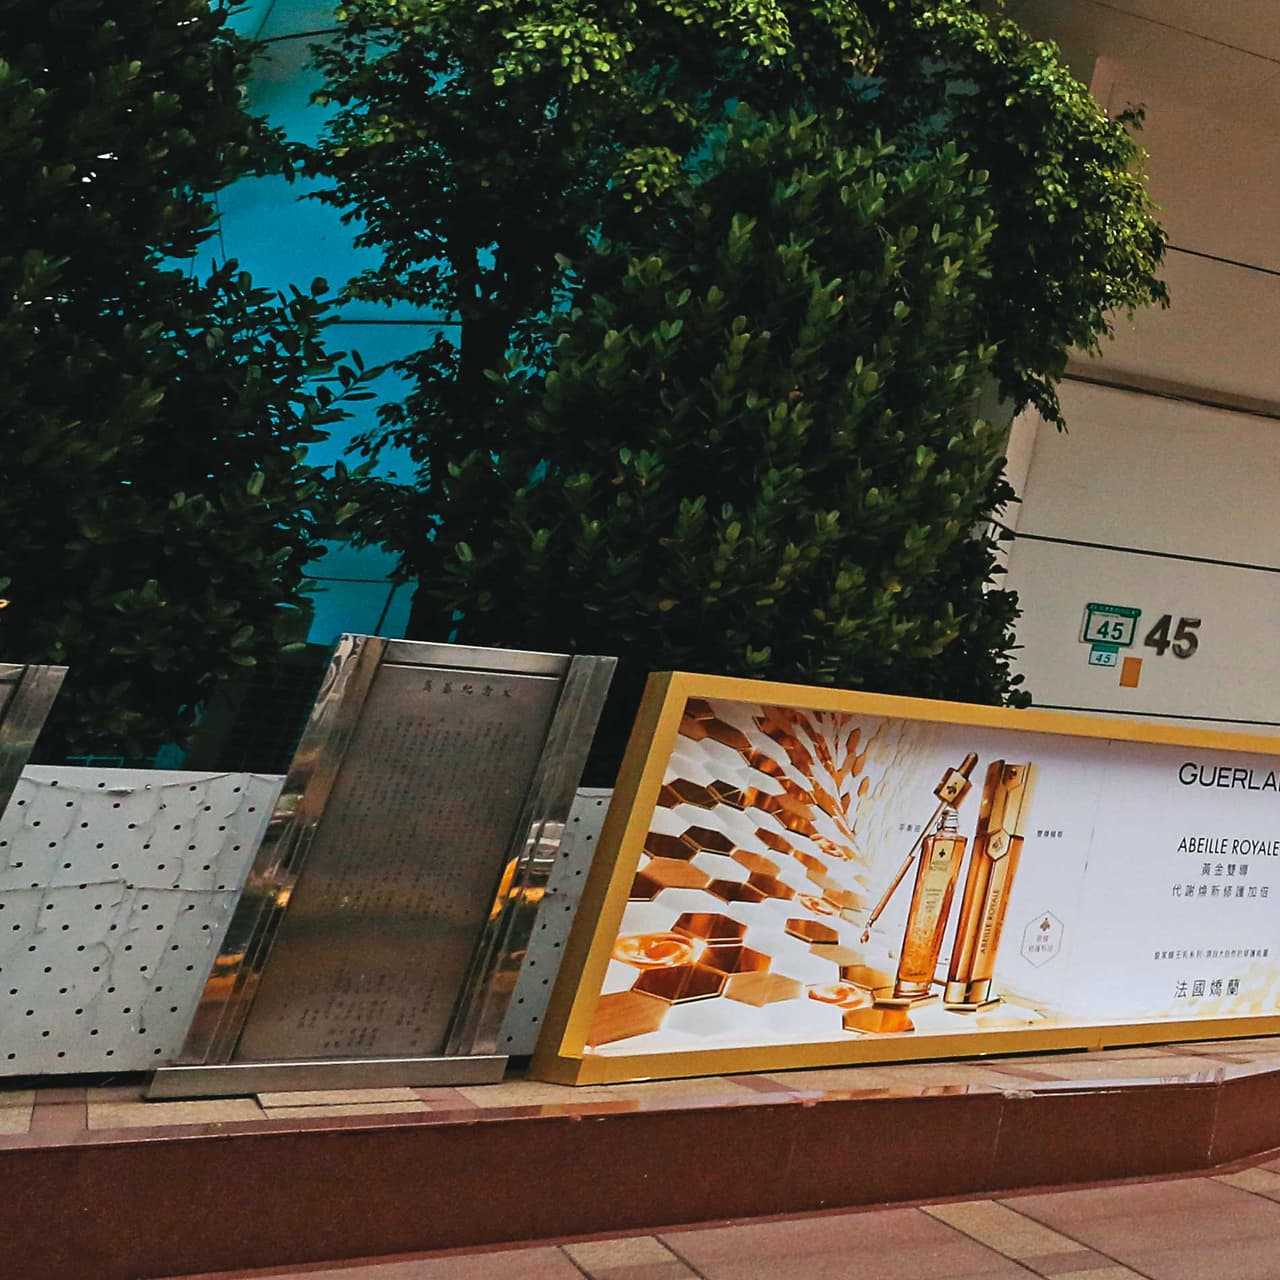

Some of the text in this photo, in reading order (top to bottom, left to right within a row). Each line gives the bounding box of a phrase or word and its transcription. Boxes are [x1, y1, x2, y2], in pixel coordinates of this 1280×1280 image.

[1097, 620, 1124, 640] 45
[1144, 614, 1202, 659] 45
[1095, 654, 1111, 664] 45
[1177, 836, 1280, 857] ABEILLE ROYALE
[1174, 978, 1241, 999] 法國嬌蘭
